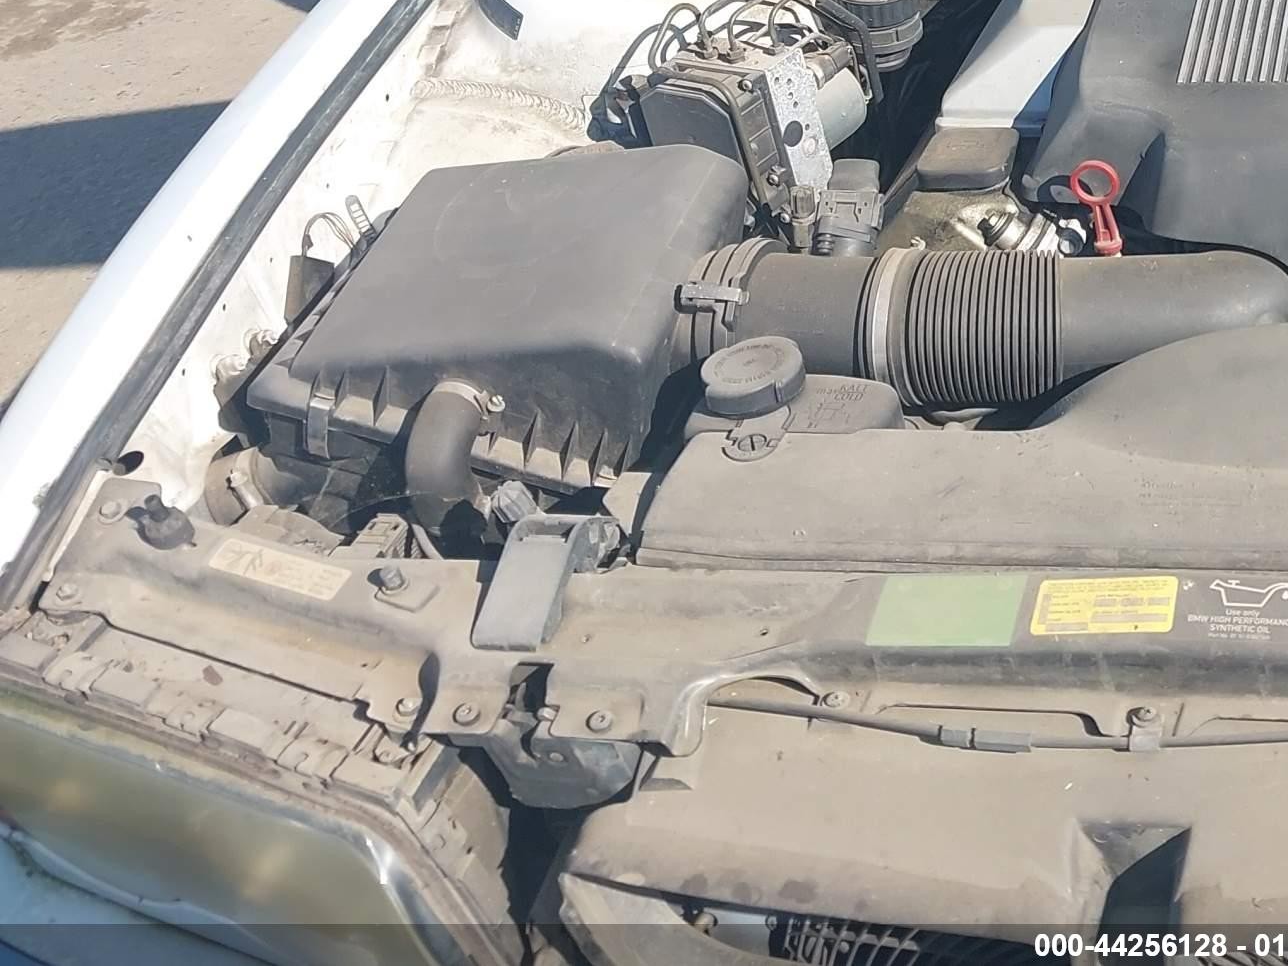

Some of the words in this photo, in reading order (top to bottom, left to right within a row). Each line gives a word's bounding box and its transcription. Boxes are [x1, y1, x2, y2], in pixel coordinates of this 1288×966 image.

[1225, 608, 1242, 616] Use
[1242, 610, 1261, 618] only
[1187, 614, 1209, 622] BMW
[1209, 615, 1232, 624] HIGH
[1209, 624, 1256, 633] SYNTHETIC
[1257, 625, 1271, 634] OIL
